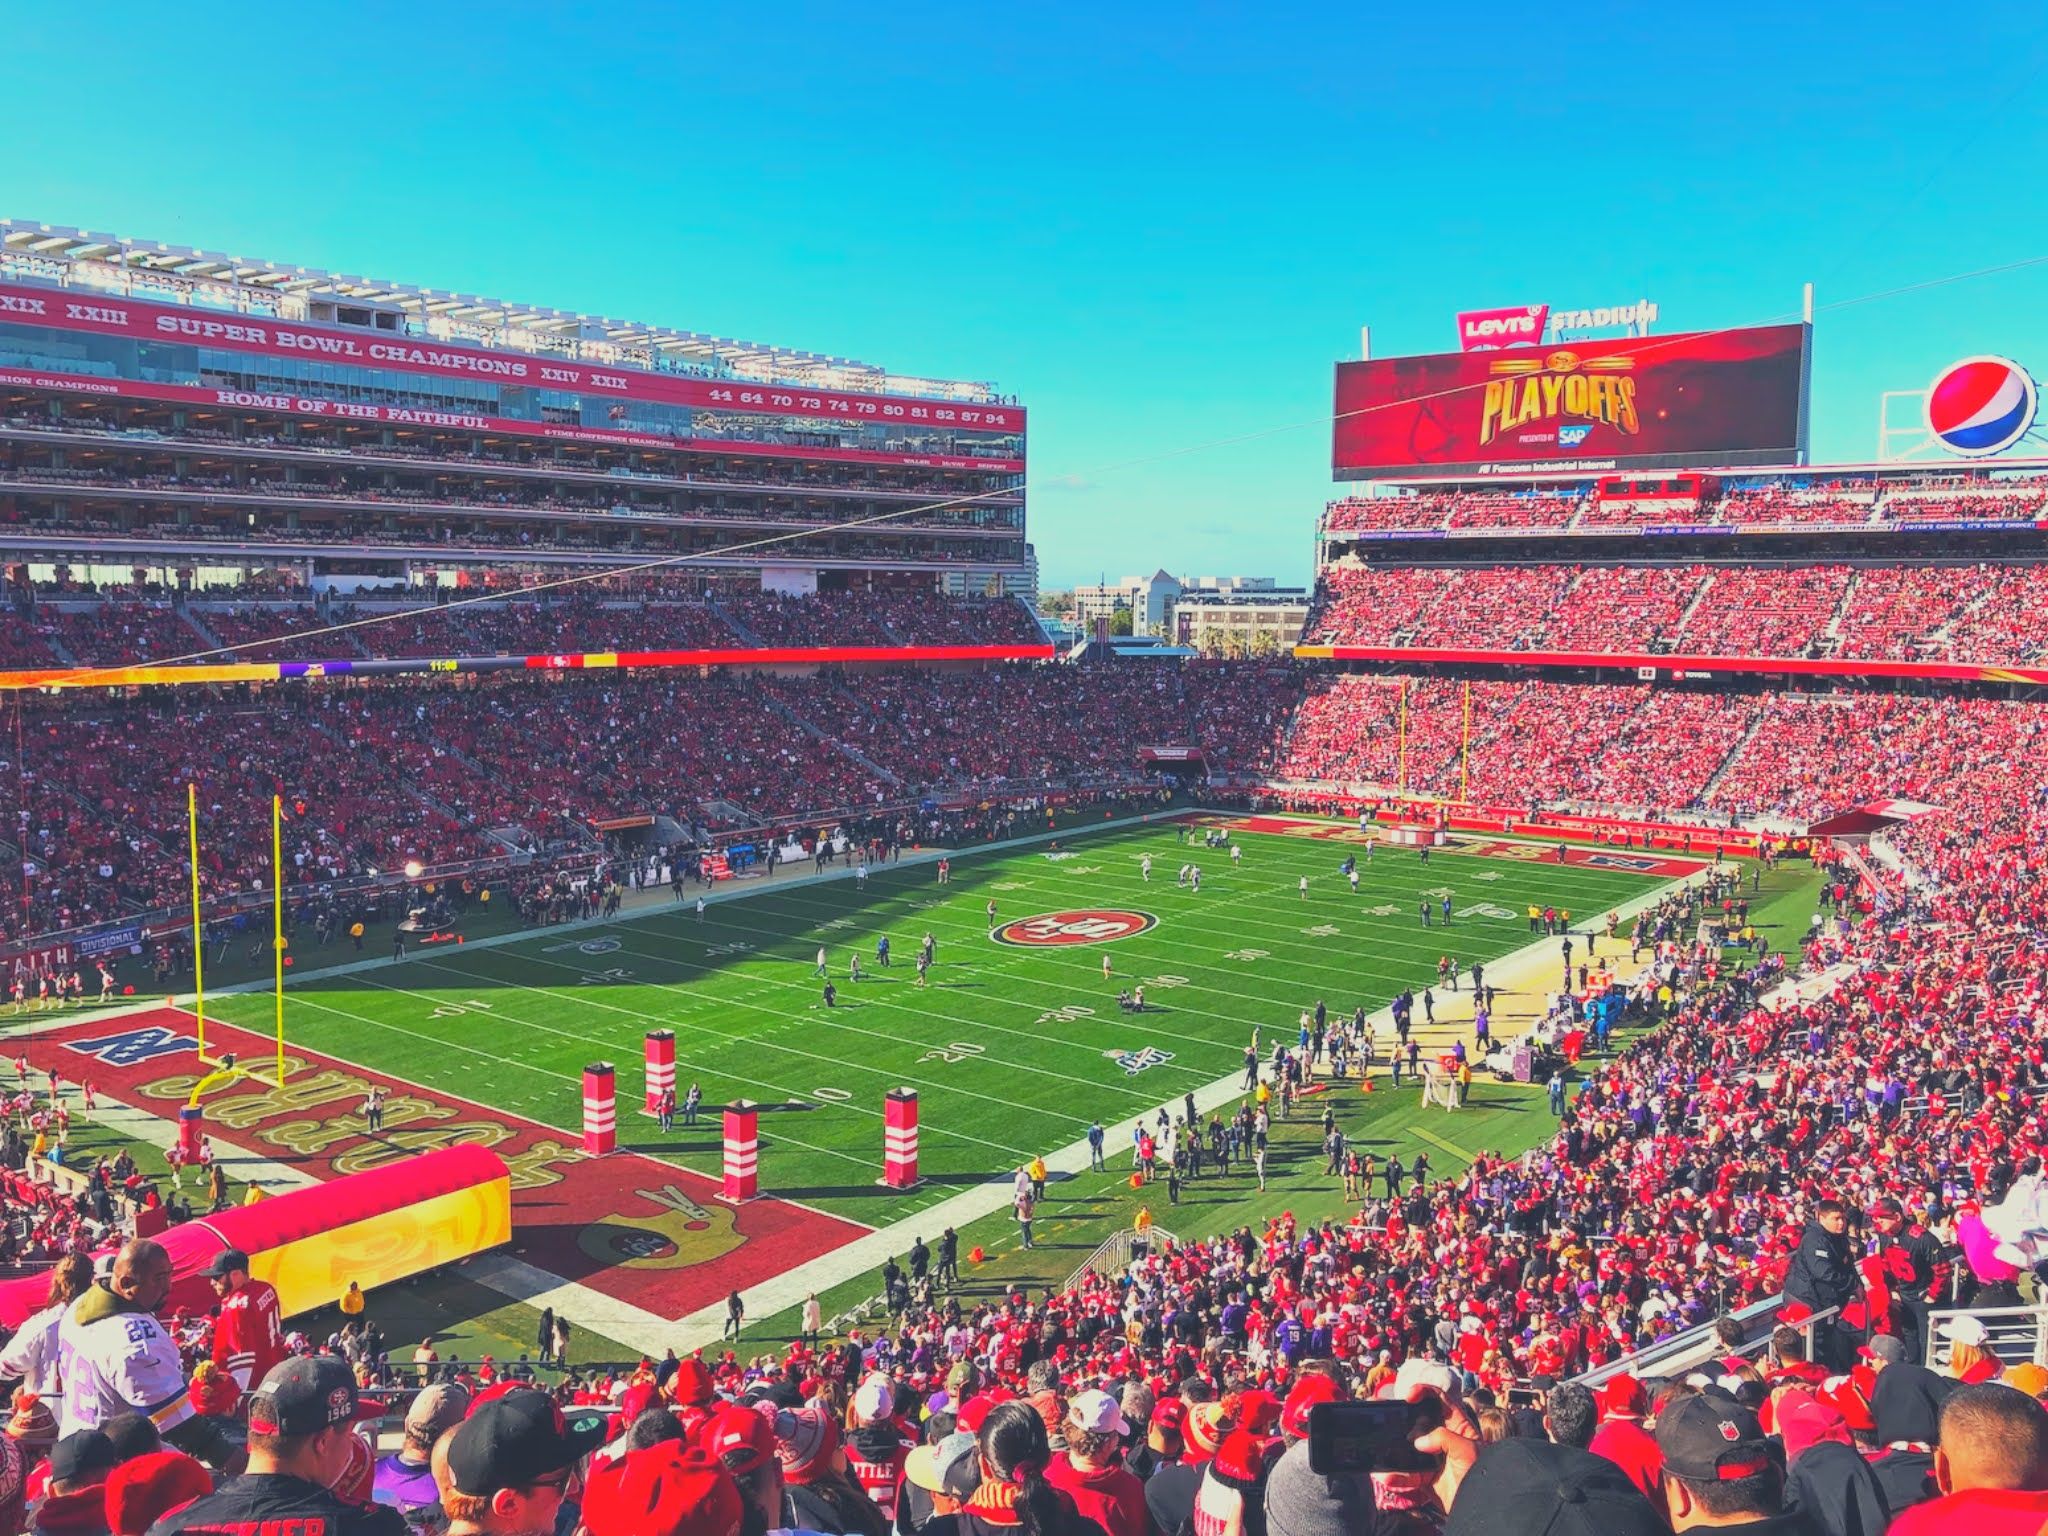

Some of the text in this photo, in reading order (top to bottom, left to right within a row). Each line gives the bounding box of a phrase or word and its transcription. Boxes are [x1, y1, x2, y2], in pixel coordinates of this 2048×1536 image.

[66, 303, 128, 325] XXIII
[1551, 302, 1660, 330] STADIUM
[156, 316, 628, 390] SUPER BOWL CHAMPIONS XXIV XXIX
[35, 378, 119, 393] CHAMPIONS
[216, 391, 490, 429] HOME OF THE FAITHFUL
[709, 389, 733, 402] 44
[740, 392, 764, 404] 64
[771, 394, 793, 407] 70
[800, 397, 821, 410] 73
[828, 399, 849, 412] 74
[855, 402, 877, 414] 79
[883, 404, 905, 416] 80
[911, 406, 929, 418] 81
[935, 409, 956, 421] 82
[985, 413, 1006, 425] 94
[1480, 375, 1640, 446] PLAYOFFS
[1558, 429, 1586, 444] SAP
[1492, 464, 1532, 473] Foxconn
[1533, 461, 1577, 472] Industrial
[1578, 460, 1616, 470] Internet
[1685, 671, 1712, 680] TOYOTA
[81, 931, 134, 951] DIVISIONAL
[327, 1402, 352, 1423] 1946
